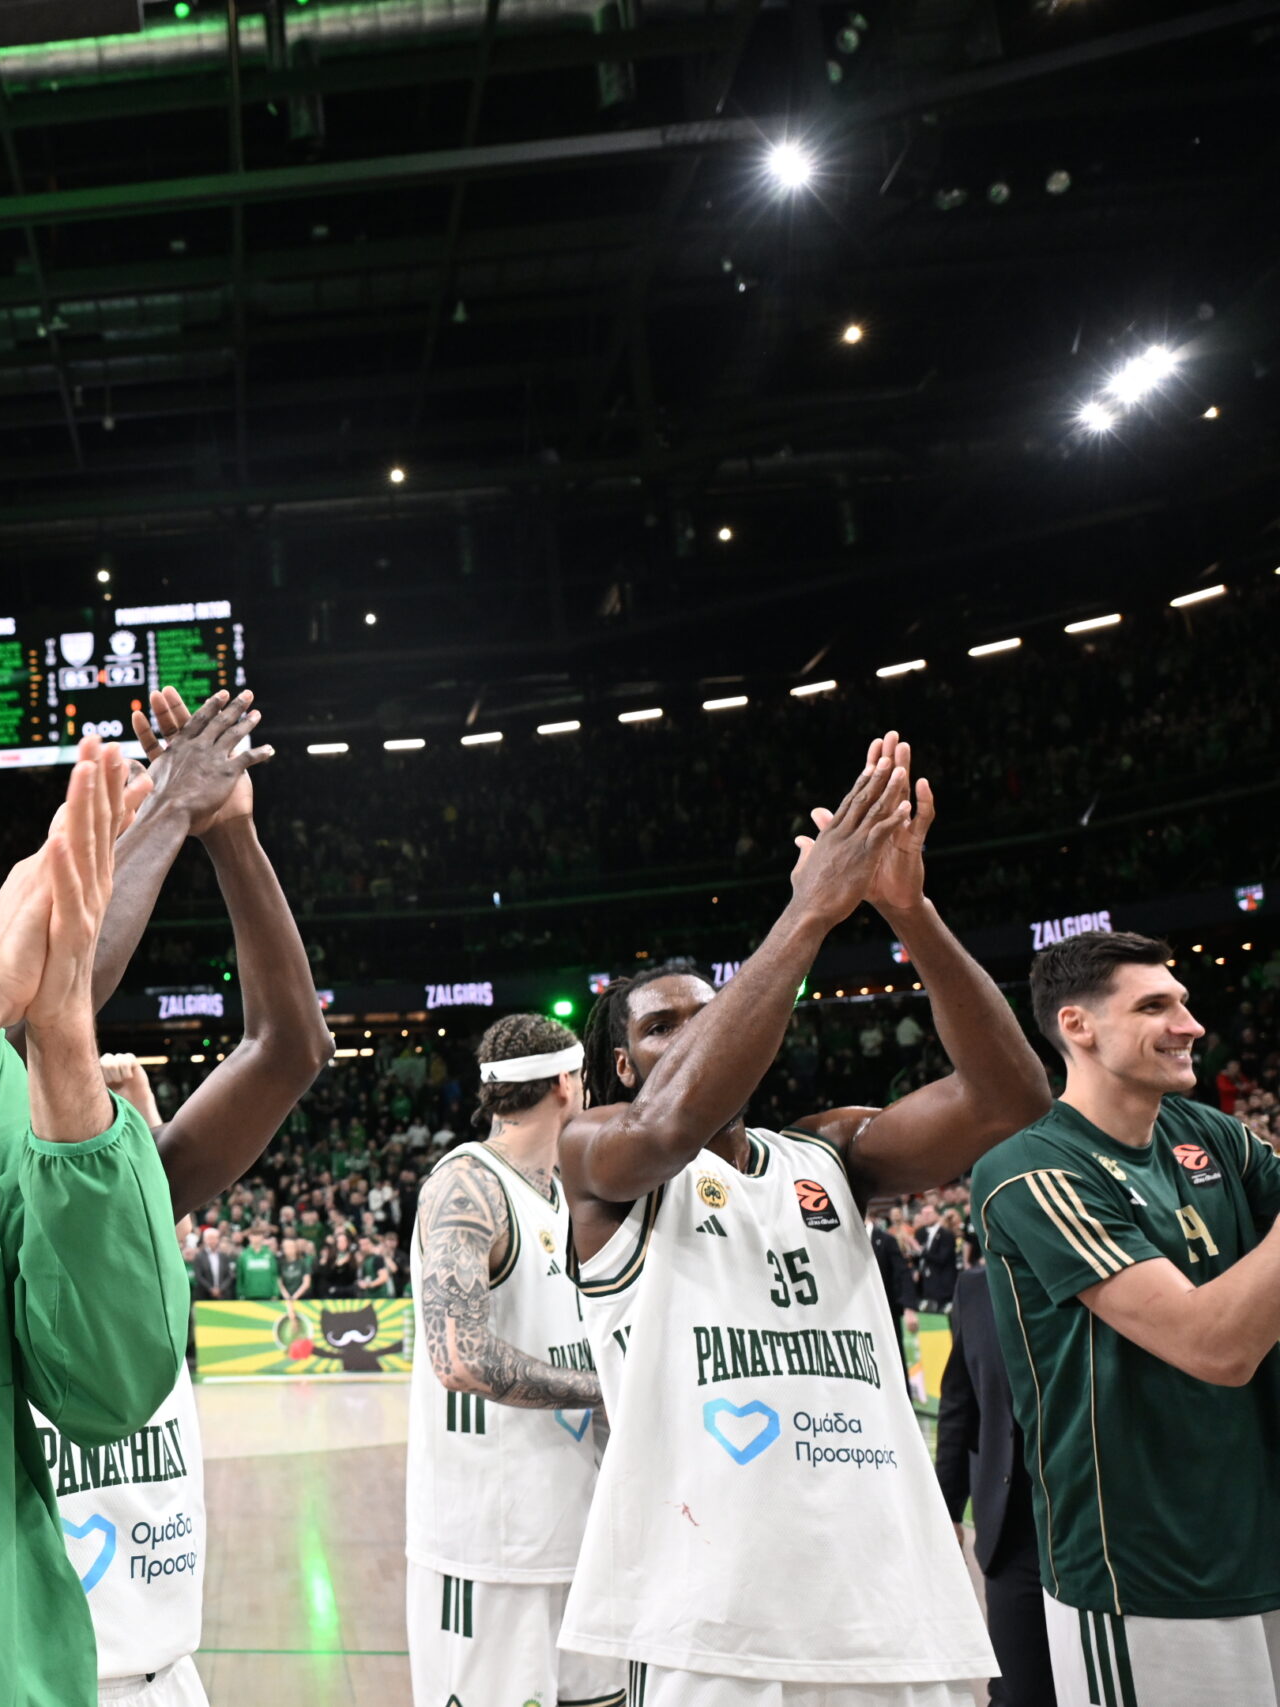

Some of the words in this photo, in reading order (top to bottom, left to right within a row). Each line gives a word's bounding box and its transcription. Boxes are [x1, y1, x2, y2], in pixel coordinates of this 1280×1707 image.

[1030, 910, 1112, 951] ZALGIRIS
[711, 961, 741, 987] ZA
[158, 993, 223, 1019] ZALGIRIS
[425, 981, 493, 1009] ZALGIRIS
[767, 1247, 818, 1308] 35
[693, 1326, 881, 1389] PANATHINAIKOS
[793, 1411, 862, 1437] Ομάδα
[795, 1441, 897, 1469] Προσφοράς
[131, 1551, 197, 1584] Προσφ
